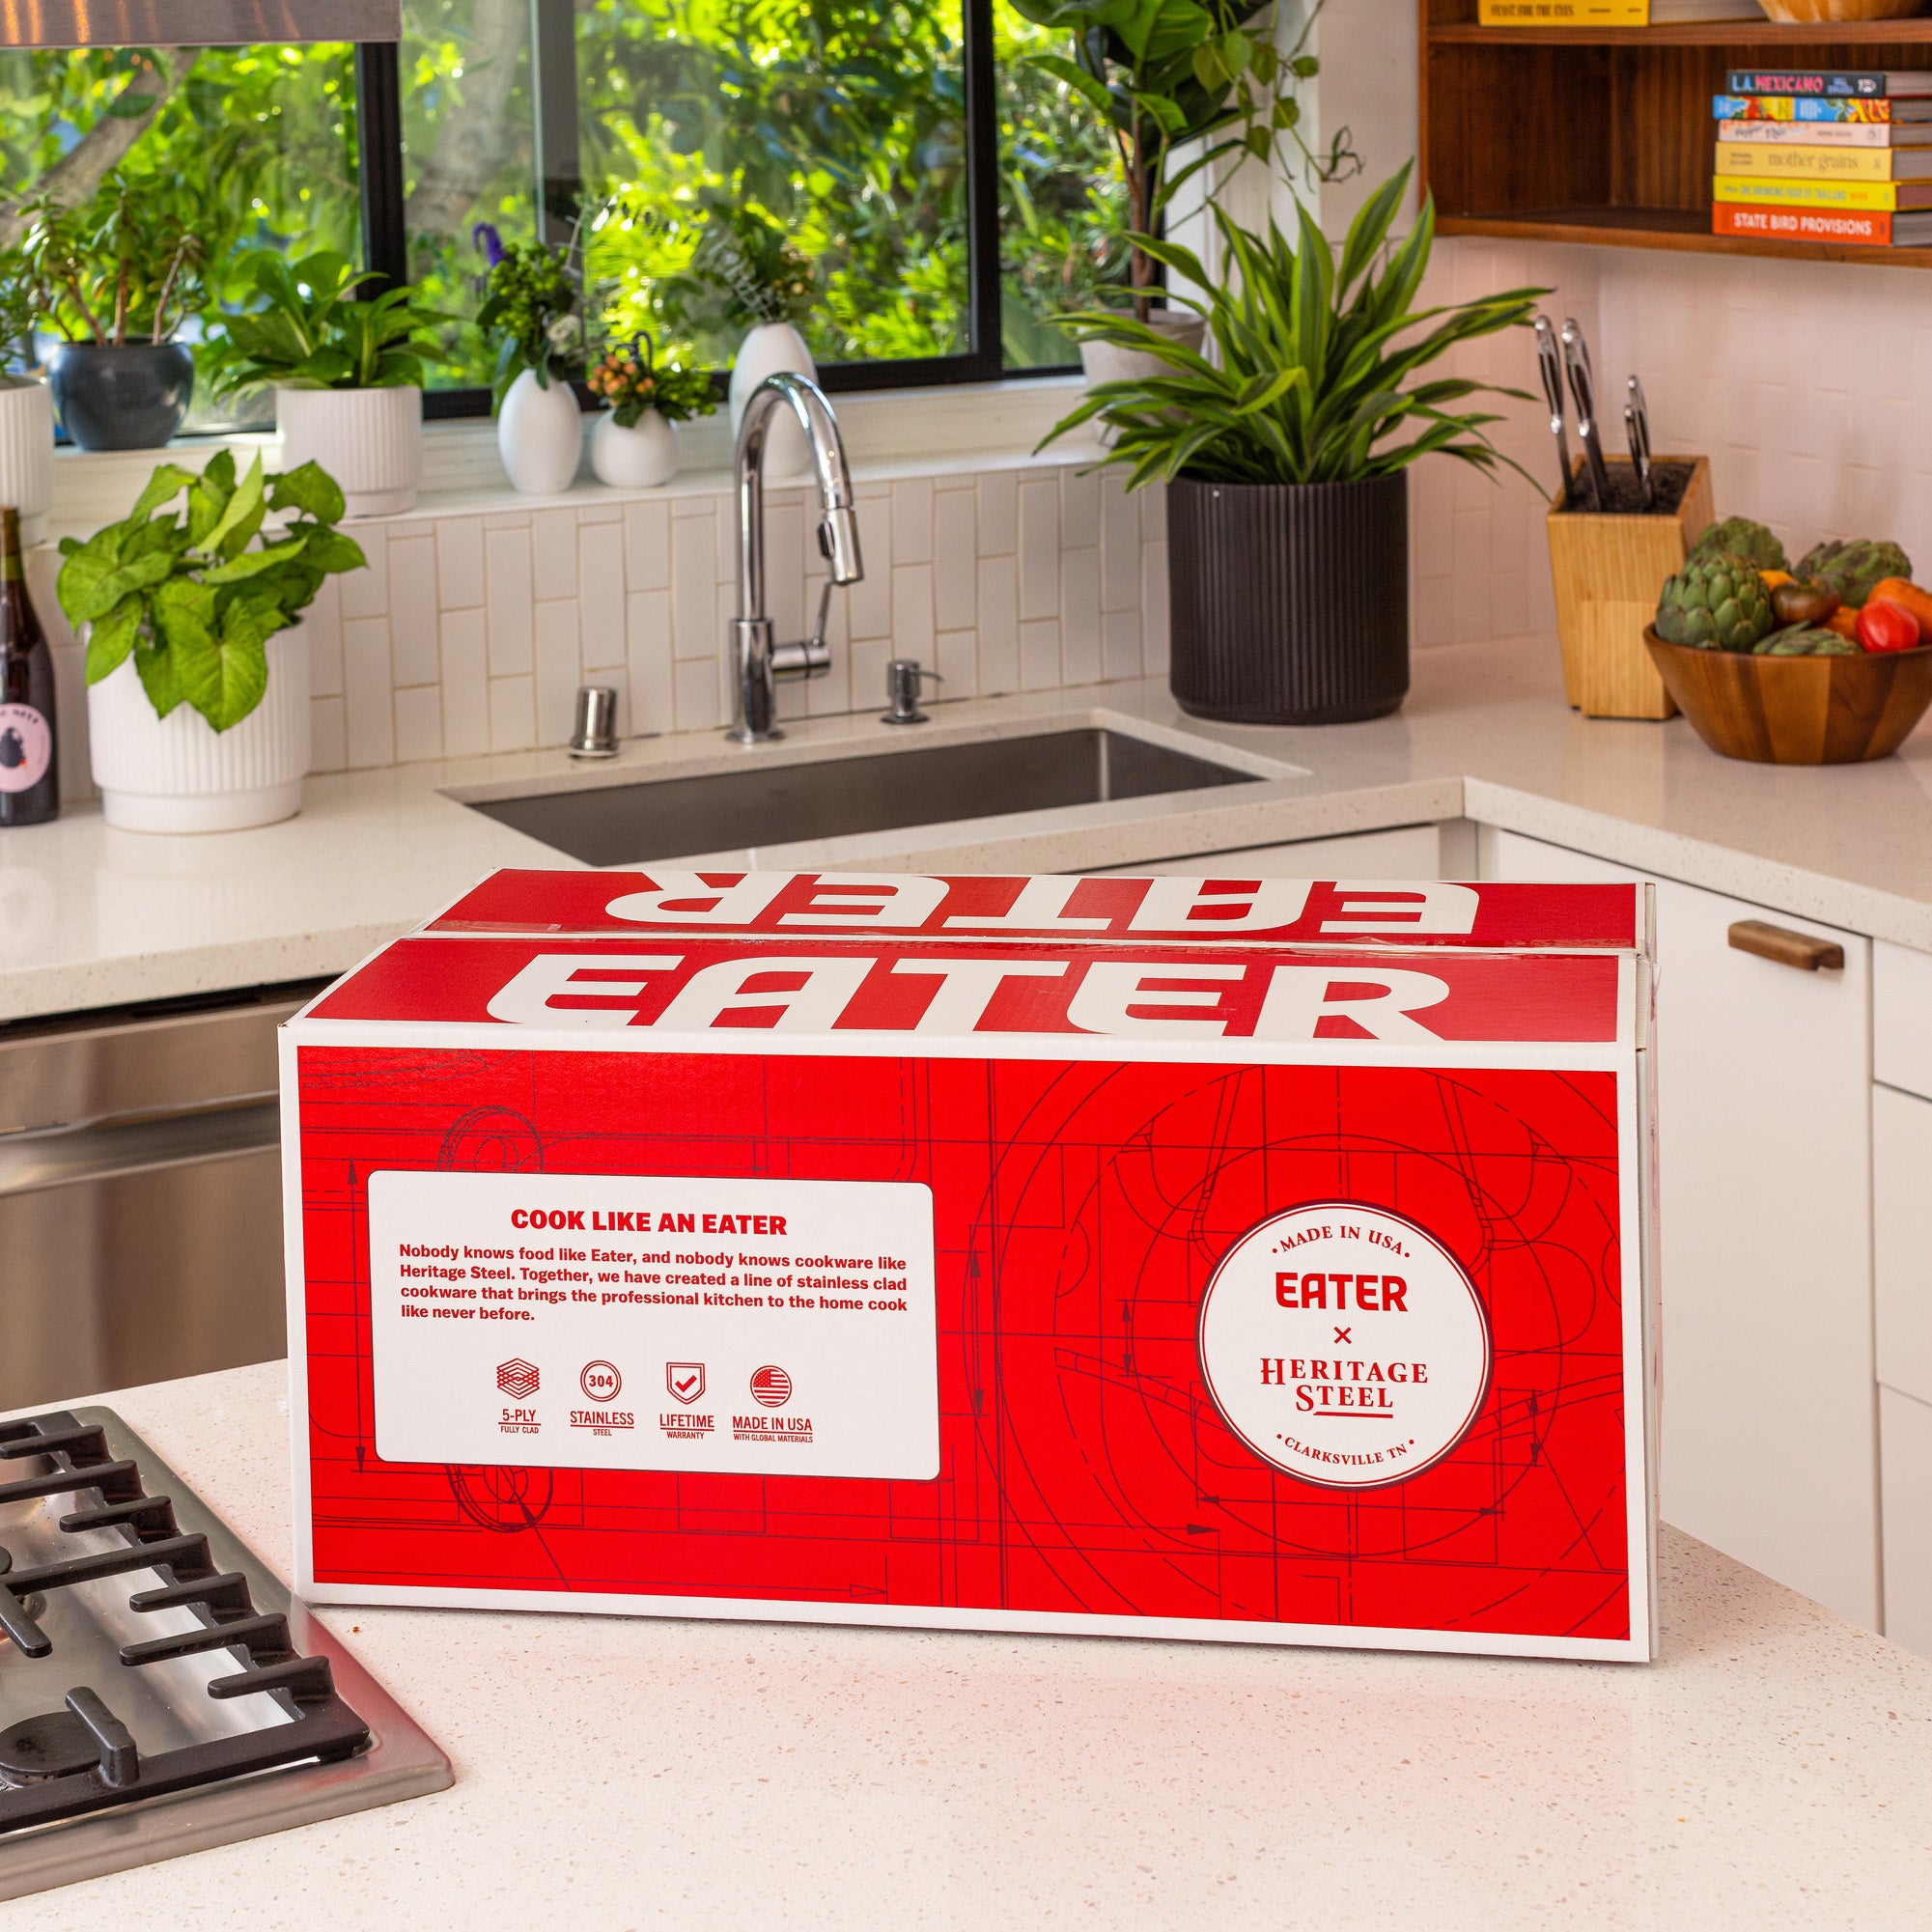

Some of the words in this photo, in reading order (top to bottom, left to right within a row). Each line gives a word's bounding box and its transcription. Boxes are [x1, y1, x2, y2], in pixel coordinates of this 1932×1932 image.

[1755, 75, 1824, 93] MEXICANO
[1768, 150, 1815, 167] mother
[1817, 155, 1860, 172] grains
[1733, 211, 1768, 230] STATE
[1769, 214, 1799, 232] BIRD
[1800, 215, 1873, 237] PROVISIONS
[605, 872, 1480, 935] EATER
[487, 954, 1450, 1041] EATER
[511, 1208, 586, 1231] COOK
[592, 1211, 652, 1232] LIKE
[657, 1212, 695, 1234] AN
[702, 1213, 788, 1236] EATER
[1280, 1226, 1333, 1252] MADE
[1339, 1226, 1361, 1240] IN
[1368, 1230, 1402, 1255] USA
[400, 1245, 459, 1261] Nobody
[464, 1246, 514, 1259] knows
[518, 1247, 553, 1260] food
[559, 1248, 586, 1261] like
[592, 1249, 636, 1265] Eater,
[642, 1251, 670, 1263] and
[676, 1251, 734, 1268] nobody
[739, 1253, 790, 1267] knows
[796, 1255, 873, 1269] cookware
[879, 1256, 906, 1270] like
[401, 1265, 465, 1281] Heritage
[471, 1266, 515, 1279] Steel.
[519, 1268, 593, 1284] Together,
[598, 1273, 620, 1282] we
[625, 1271, 660, 1283] have
[665, 1274, 725, 1285] created
[731, 1276, 739, 1285] a
[744, 1274, 772, 1286] line
[777, 1274, 793, 1287] of
[798, 1275, 868, 1289] stainless
[874, 1277, 907, 1290] clad
[401, 1285, 477, 1299] cookware
[482, 1287, 514, 1300] that
[518, 1288, 567, 1303] brings
[572, 1289, 597, 1302] the
[602, 1291, 698, 1305] professional
[704, 1293, 763, 1306] kitchen
[768, 1296, 784, 1307] to
[789, 1296, 815, 1308] the
[820, 1296, 863, 1309] home
[868, 1299, 907, 1310] cook
[1275, 1272, 1409, 1312] EATER
[402, 1305, 428, 1317] like
[433, 1308, 475, 1319] never
[480, 1307, 534, 1320] before.
[588, 1374, 614, 1387] 304
[1260, 1358, 1428, 1384] HERITAGE
[1296, 1385, 1394, 1413] STEEL
[502, 1409, 537, 1422] 5-PLY
[570, 1411, 634, 1425] STAINLESS
[659, 1414, 715, 1428] LIFETIME
[732, 1416, 769, 1430] MADE
[770, 1417, 784, 1431] IN
[787, 1418, 813, 1432] USA
[666, 1431, 705, 1440] WARRANTY
[1284, 1437, 1385, 1466] CLARKSVILLE
[1386, 1443, 1408, 1459] TN
